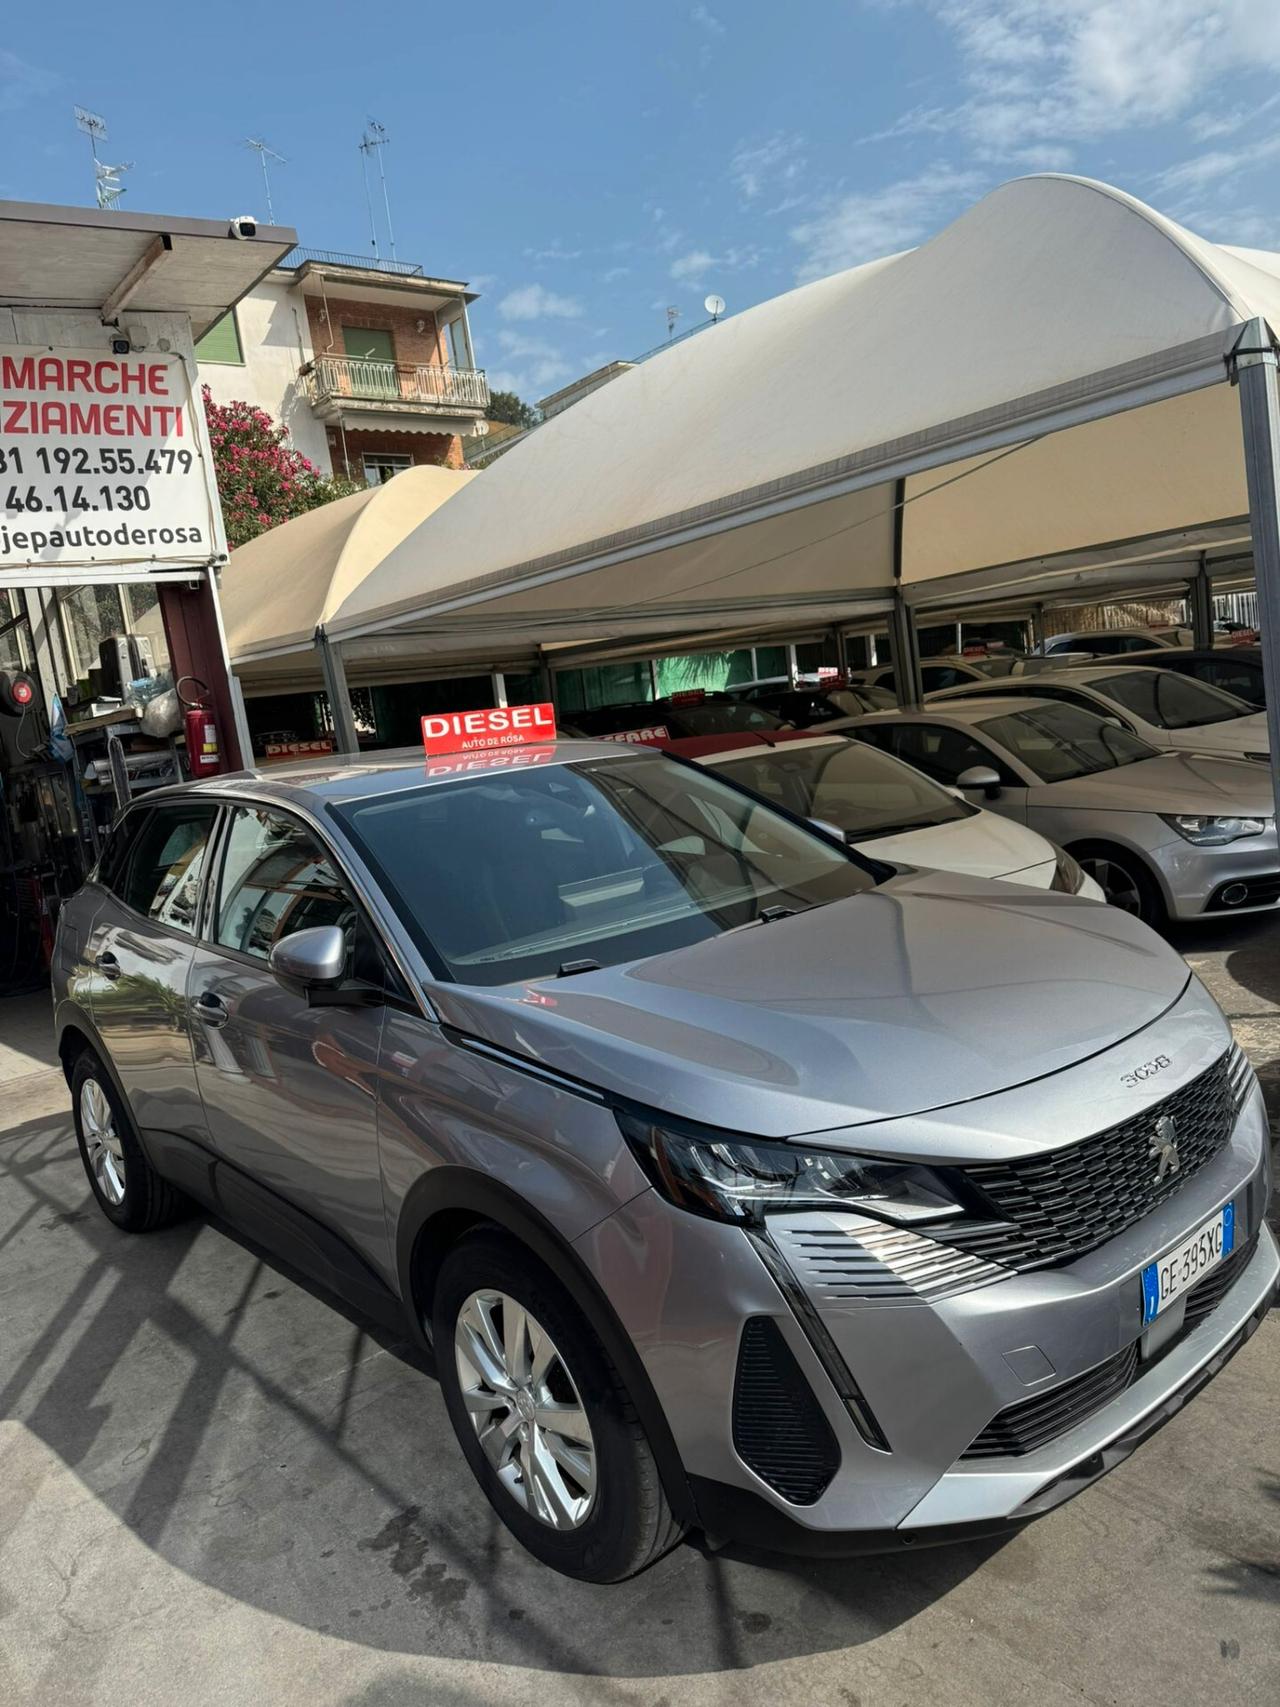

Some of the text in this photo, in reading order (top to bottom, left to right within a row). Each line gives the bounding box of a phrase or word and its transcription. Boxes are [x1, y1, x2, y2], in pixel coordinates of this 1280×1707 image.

[2, 356, 169, 395] MARCHE
[0, 400, 183, 438] ZIAMENTI
[36, 447, 193, 475] 192.55.479
[5, 486, 151, 513] 46.14.130
[1, 522, 203, 554] jepautoderosa
[424, 708, 553, 738] DIESEL
[267, 741, 331, 754] DIESEL
[462, 734, 524, 749] AUTO DE ROSA
[1119, 1054, 1171, 1089] 3008
